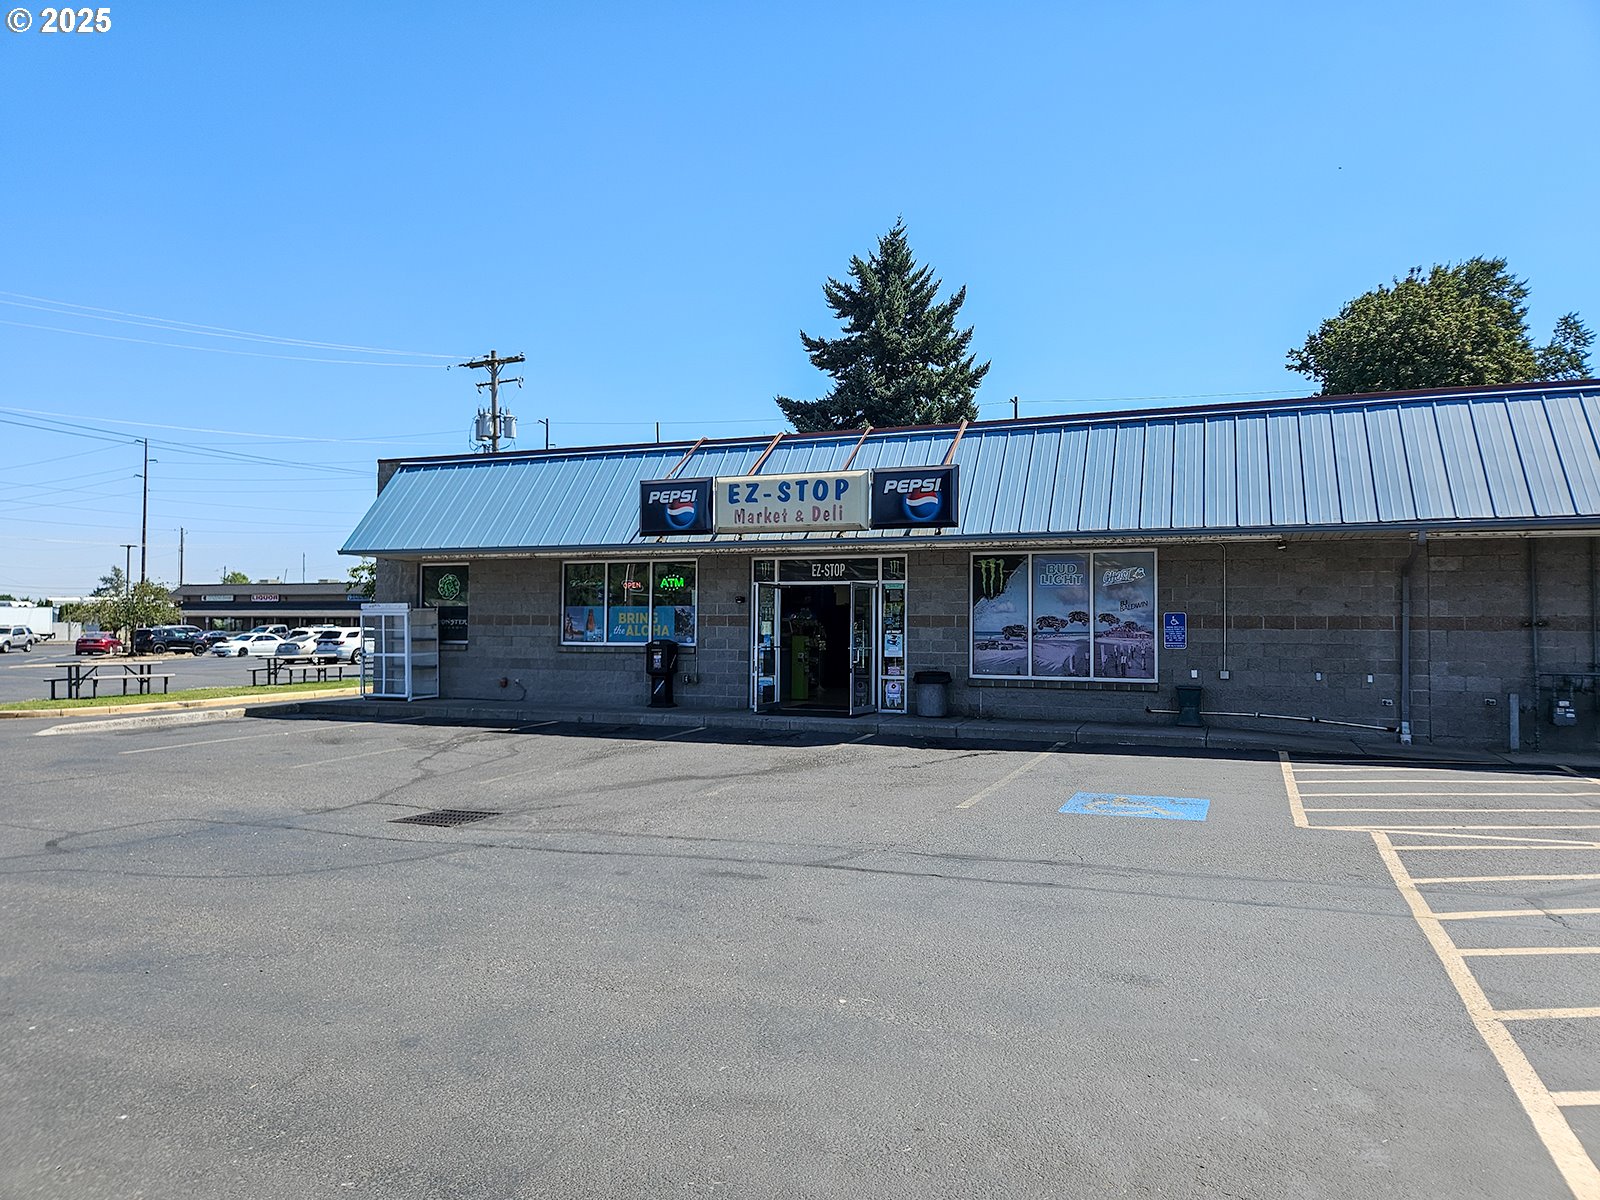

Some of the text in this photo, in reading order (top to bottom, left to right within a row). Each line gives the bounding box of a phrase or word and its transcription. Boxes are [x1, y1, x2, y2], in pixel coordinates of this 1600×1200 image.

[728, 479, 850, 504] EZ-STOP
[883, 477, 941, 494] PEPSI
[648, 489, 697, 504] PEPSI
[734, 505, 843, 524] Market & Deli
[812, 563, 846, 577] EZ-STOP
[1046, 563, 1078, 575] BUD
[622, 581, 642, 589] OPEN
[659, 577, 685, 588] ATM
[1040, 574, 1084, 586] LIGHT
[618, 612, 659, 624] BRING
[613, 624, 625, 635] the
[626, 625, 670, 636] ALOHA
